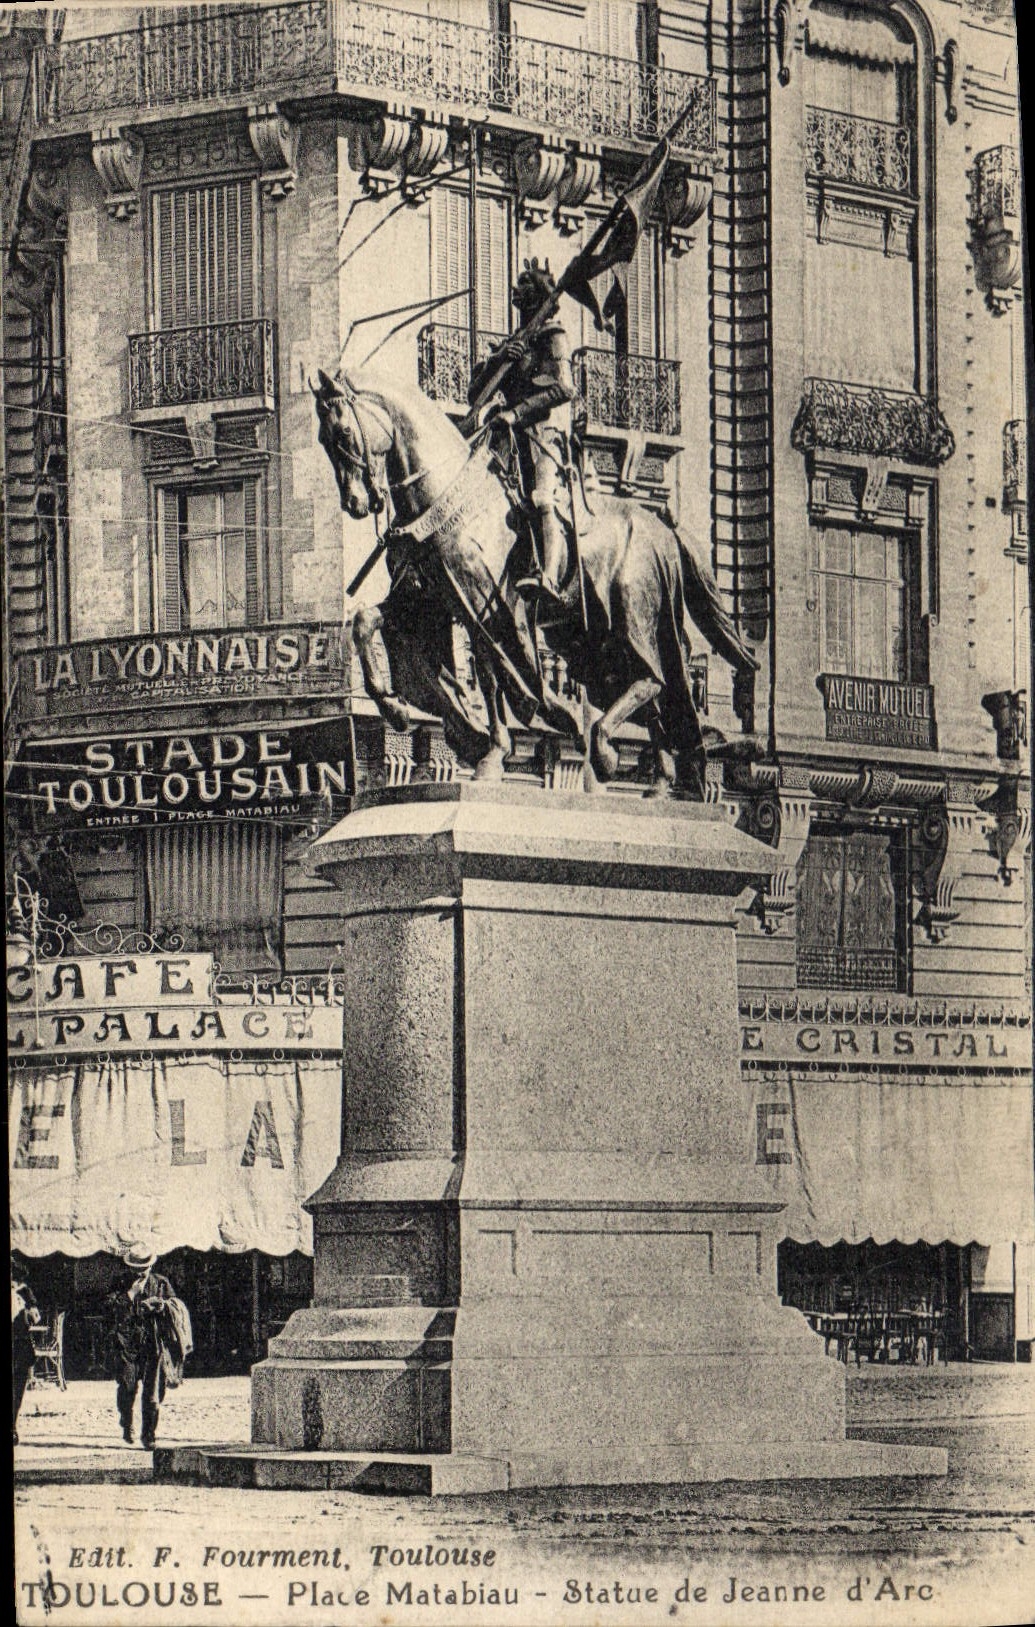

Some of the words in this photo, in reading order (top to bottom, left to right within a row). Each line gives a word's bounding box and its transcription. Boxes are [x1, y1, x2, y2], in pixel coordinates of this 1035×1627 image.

[33, 652, 78, 691] LA
[90, 633, 329, 683] LYONNAISE
[828, 679, 876, 713] AVENIR
[879, 684, 931, 719] MUTUEL
[85, 731, 293, 774] STADE
[38, 760, 347, 815] TOULOUSAIN
[226, 803, 301, 818] MATABIAU
[7, 959, 195, 1002] CAFE
[50, 1011, 314, 1046] PALACE
[796, 1027, 1008, 1058] CRISTAL
[167, 1098, 285, 1170] LA
[755, 1102, 793, 1166] E
